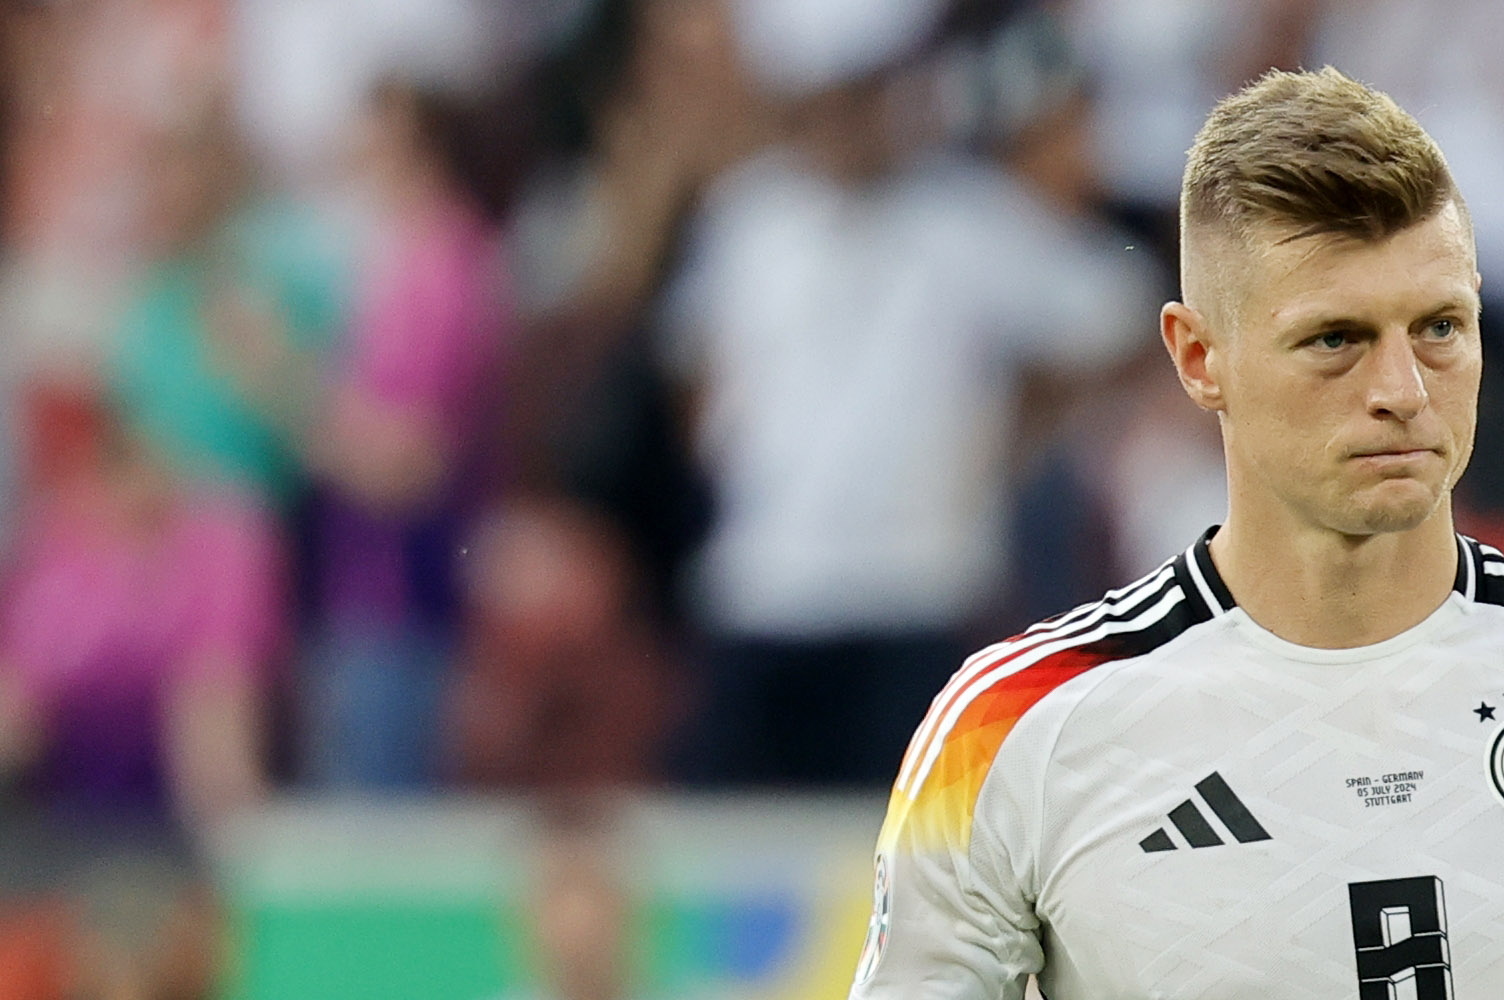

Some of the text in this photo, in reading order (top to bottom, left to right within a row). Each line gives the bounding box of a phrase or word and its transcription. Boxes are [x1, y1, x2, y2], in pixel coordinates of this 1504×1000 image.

[1345, 776, 1372, 788] SPAIN
[1382, 770, 1424, 784] GERMANY
[1357, 782, 1417, 797] 05 JULY 2024
[1364, 793, 1412, 808] STUTTGART
